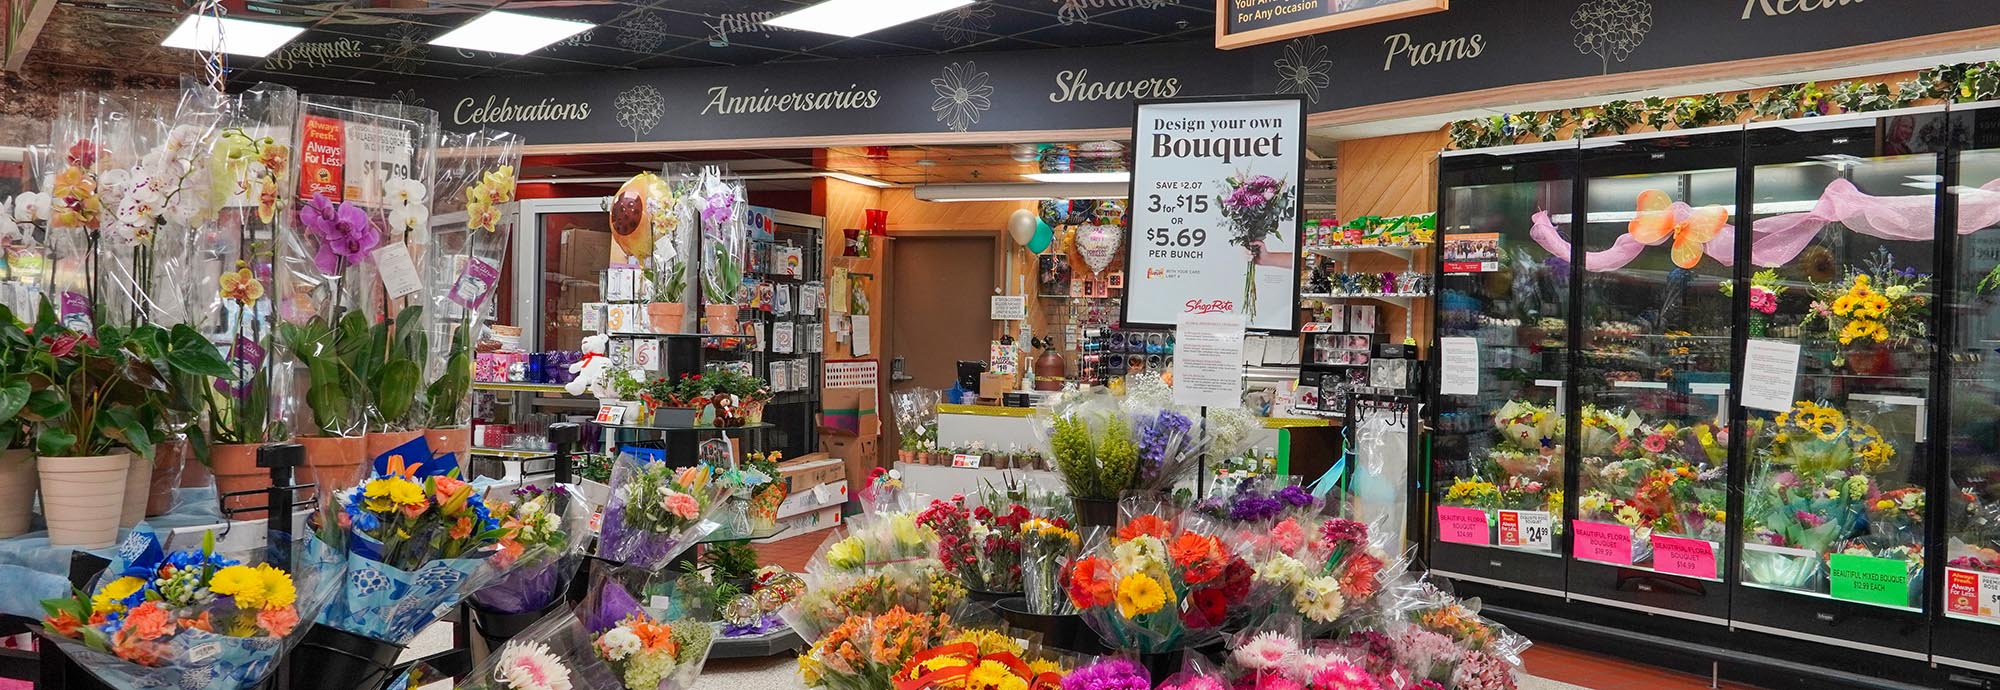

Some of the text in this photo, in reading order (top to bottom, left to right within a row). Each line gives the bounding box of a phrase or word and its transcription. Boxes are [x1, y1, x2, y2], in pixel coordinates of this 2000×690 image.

[1238, 13, 1253, 23] For
[1254, 9, 1273, 20] Any
[1274, 0, 1318, 16] Occasion
[1383, 33, 1486, 71] Proms
[1049, 68, 1182, 104] Showers
[701, 82, 881, 116] Anniversaries
[453, 96, 592, 126] Celebrations
[307, 120, 339, 132] Always
[1154, 117, 1283, 133] Design your own
[306, 141, 341, 157] Always
[1152, 132, 1283, 164] Bouquet
[305, 152, 342, 167] For Less.
[1156, 181, 1203, 189] SAVE $2.07
[1147, 194, 1208, 213] 3 for $15
[1147, 228, 1207, 247] $5.69
[1149, 250, 1203, 259] PER BUNCH
[1184, 300, 1233, 314] ShopRite
[608, 308, 624, 331] 3
[634, 343, 650, 366] 6
[1440, 514, 1469, 523] BEAUTIFUL
[1576, 529, 1630, 543] BEAUTIFUL FLORAL
[1590, 539, 1617, 548] BOUQUET
[1655, 542, 1712, 555] BEAUTIFUL FLORAL
[1671, 552, 1699, 561] BOUQUET
[1833, 568, 1906, 584] BEAUTIFUL MIXED BOUQUET
[1853, 581, 1885, 592] $12.99 EACH
[1952, 583, 1975, 592] Always
